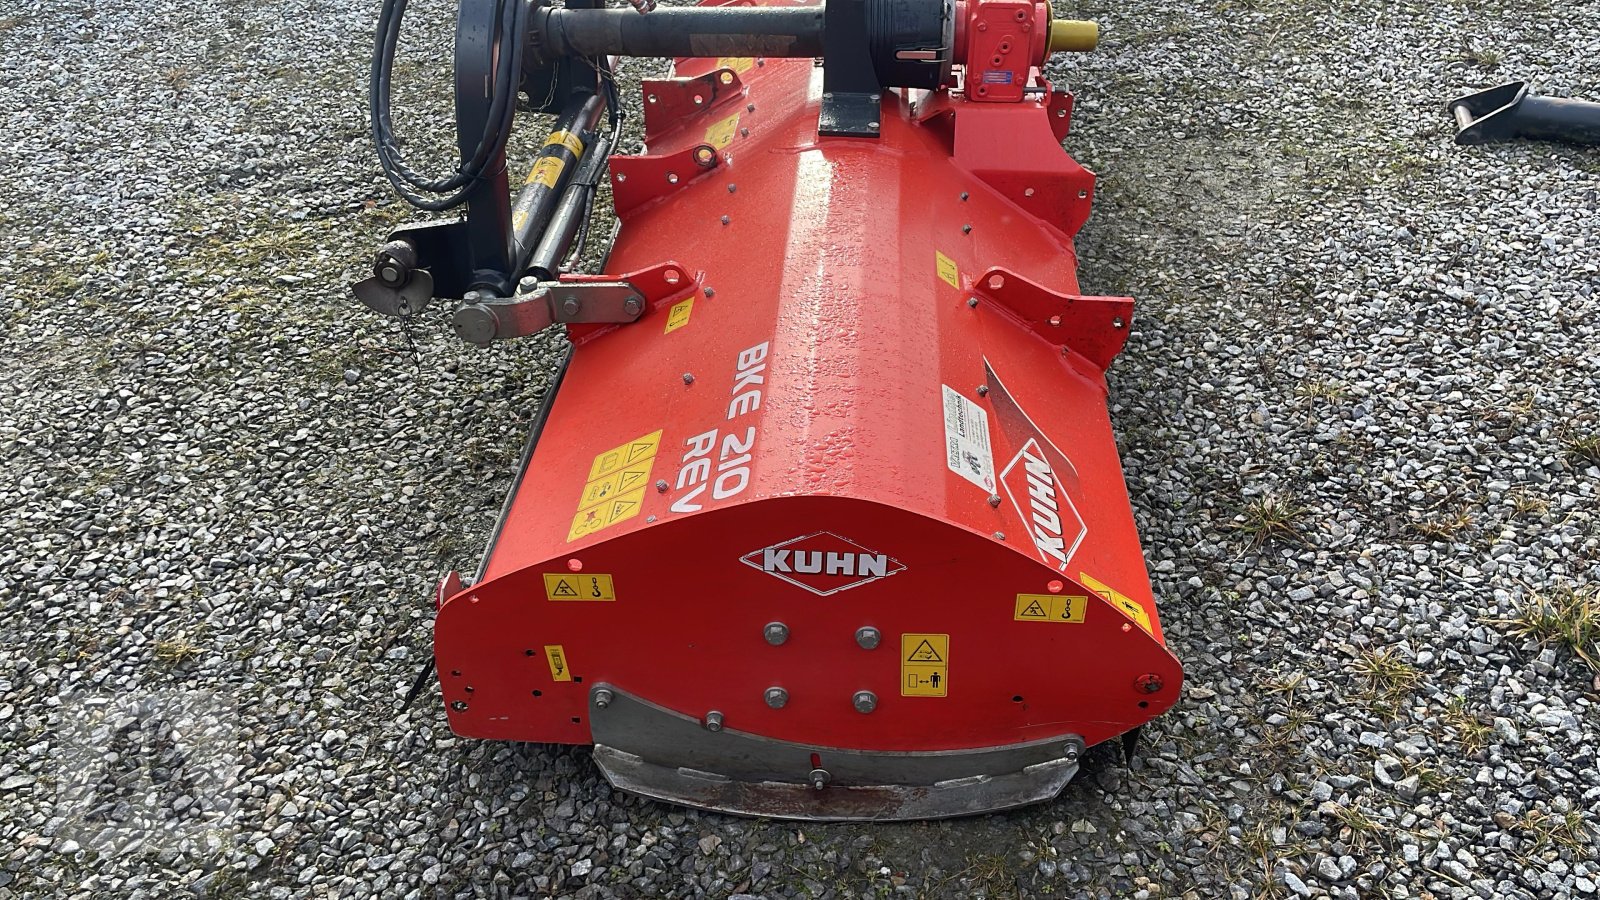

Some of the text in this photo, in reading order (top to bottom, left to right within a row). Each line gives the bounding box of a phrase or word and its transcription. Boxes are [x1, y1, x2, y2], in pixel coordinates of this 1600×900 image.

[712, 341, 769, 500] BKE 210
[956, 394, 966, 438] Landtechnik
[670, 428, 718, 513] REV
[1022, 450, 1068, 564] KUHN
[763, 548, 888, 577] KUHN
